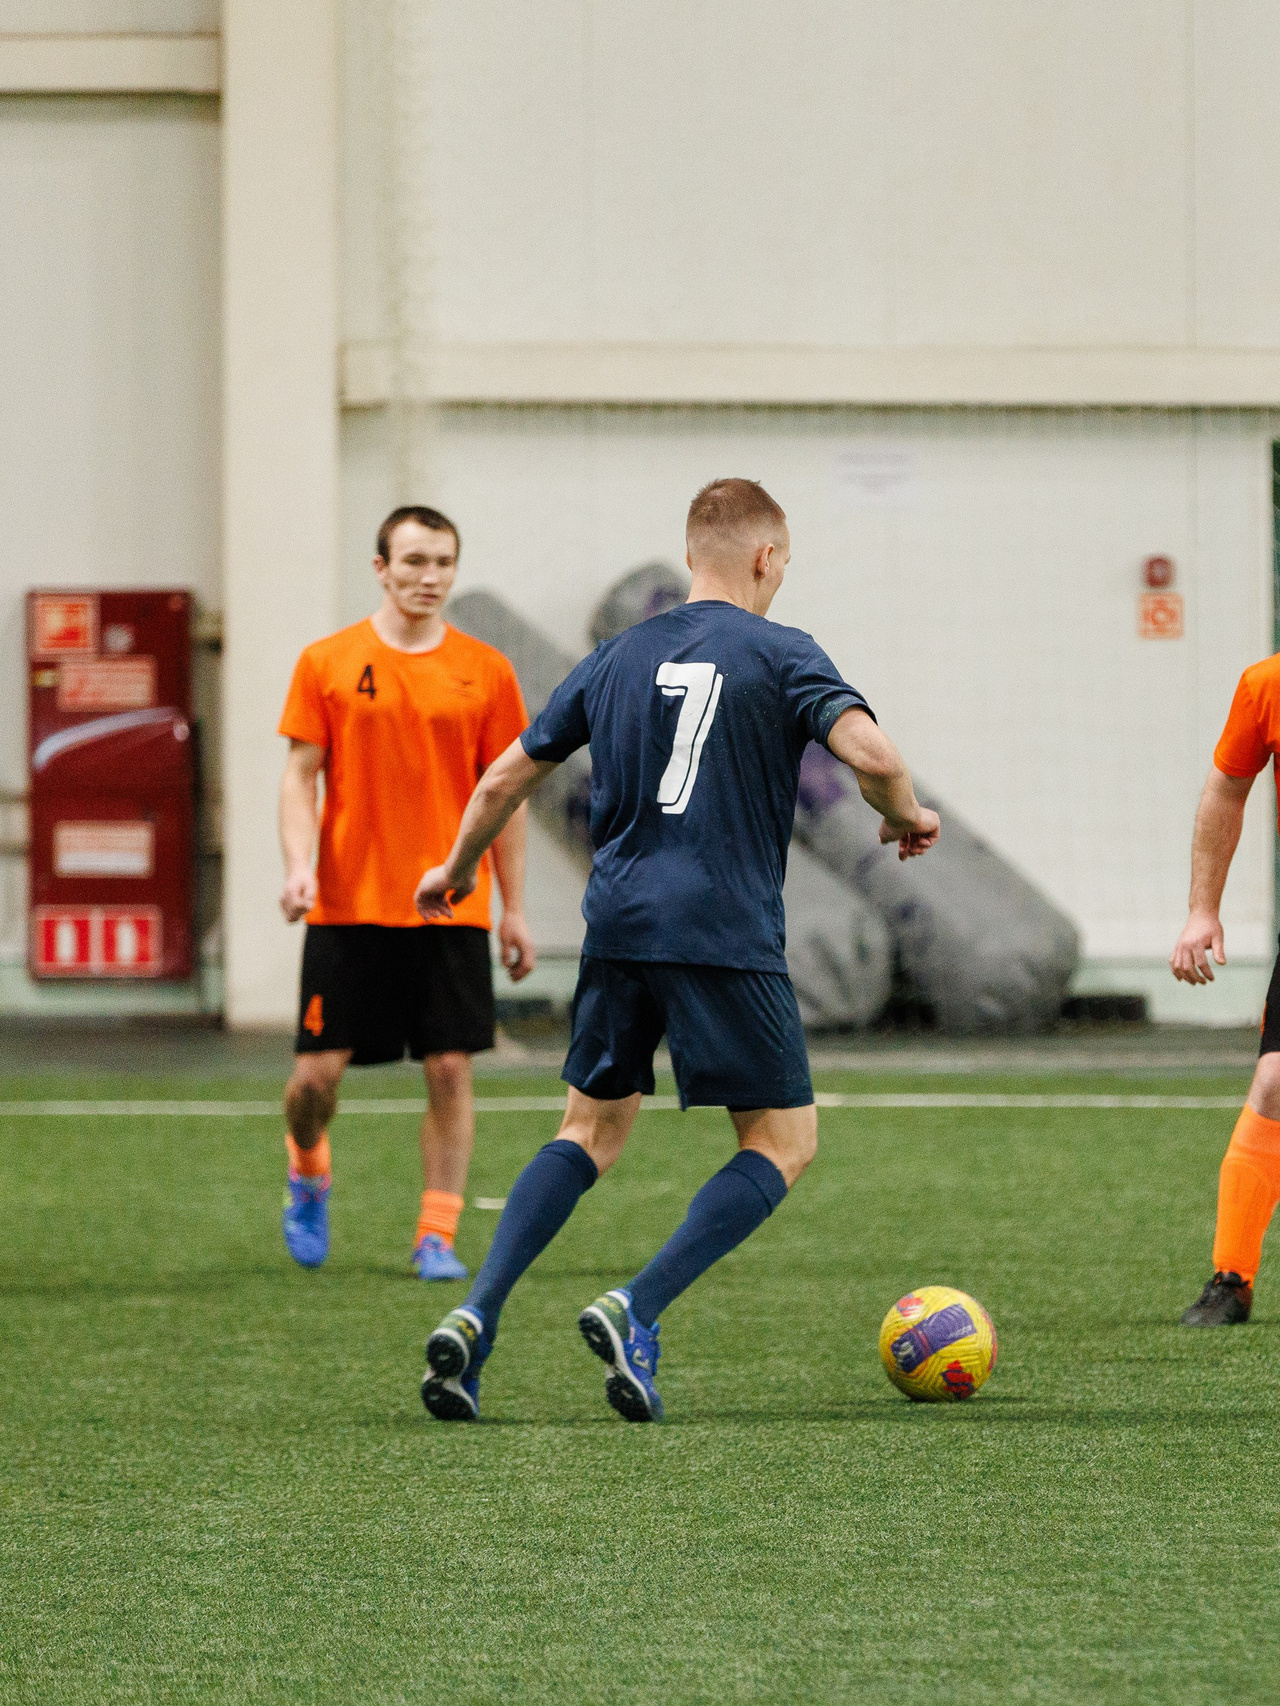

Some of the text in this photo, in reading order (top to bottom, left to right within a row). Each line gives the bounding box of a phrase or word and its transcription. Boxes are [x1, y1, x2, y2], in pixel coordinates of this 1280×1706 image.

[357, 664, 377, 700] 4
[655, 661, 724, 815] 7
[303, 994, 325, 1036] 4
